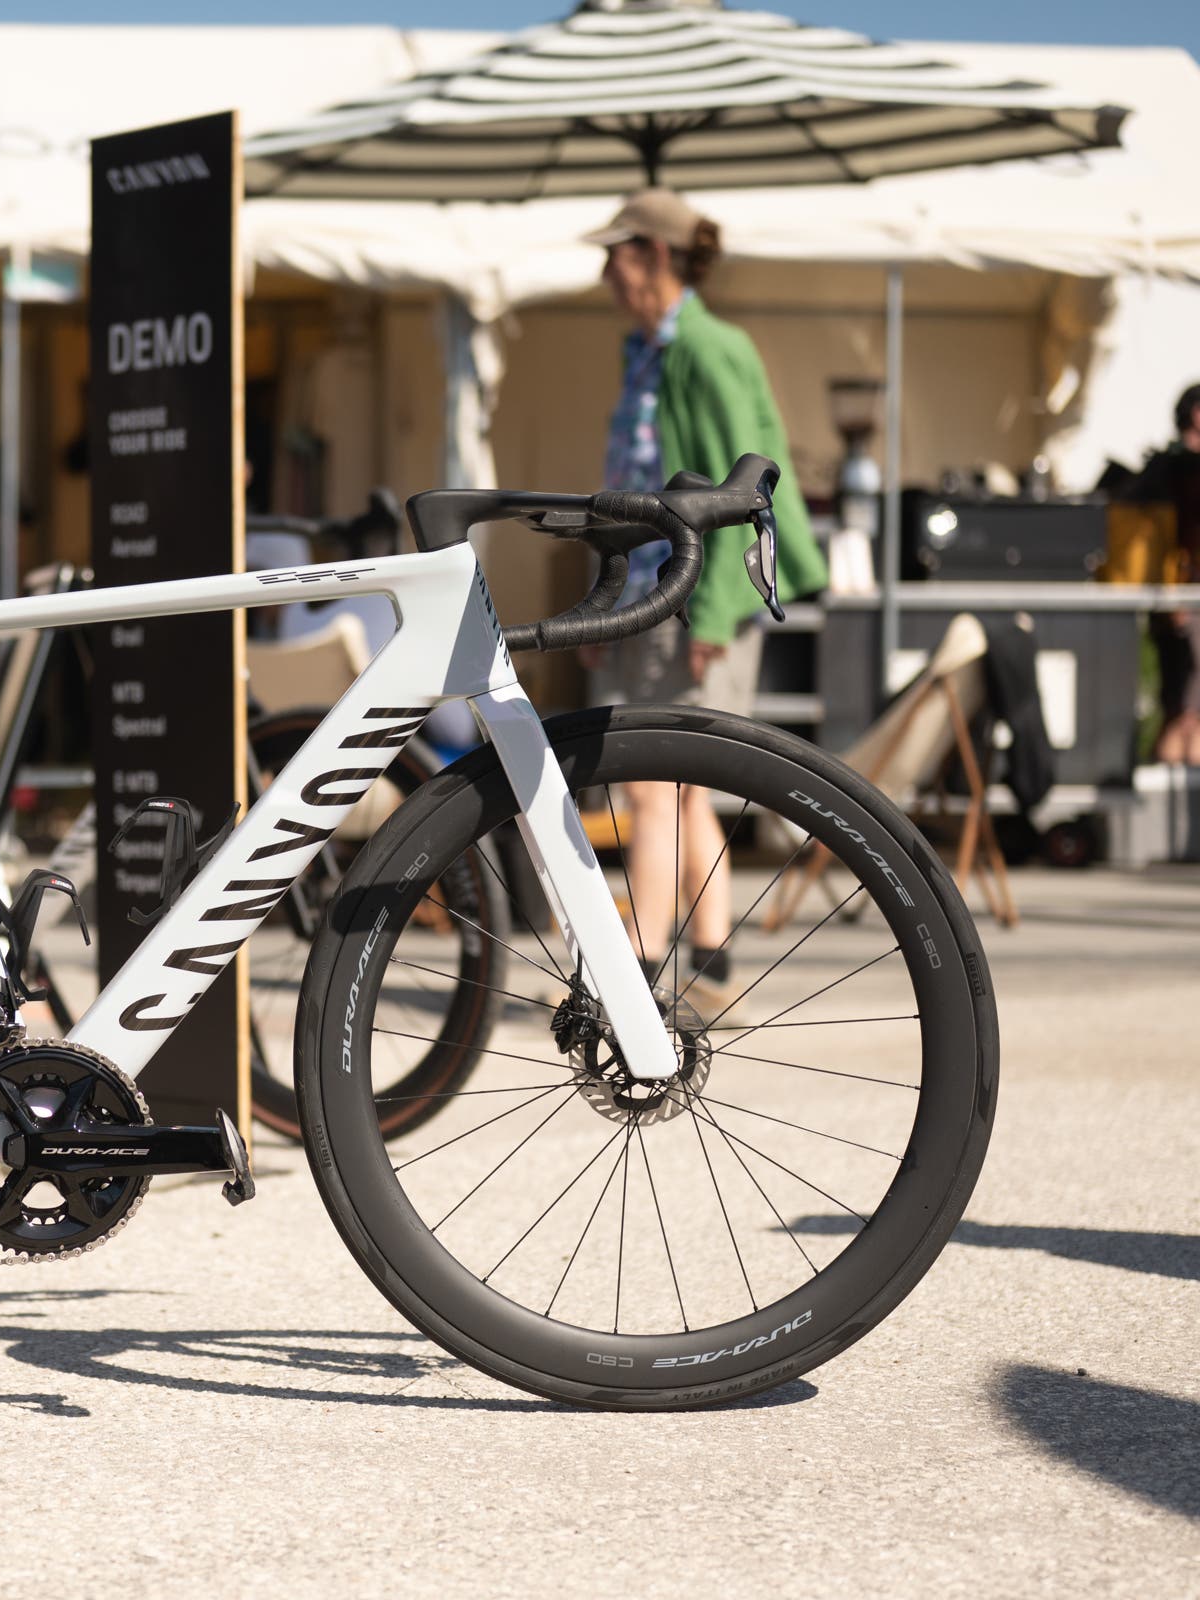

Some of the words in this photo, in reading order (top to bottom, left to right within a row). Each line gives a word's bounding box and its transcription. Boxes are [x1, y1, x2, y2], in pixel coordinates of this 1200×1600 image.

[106, 154, 211, 193] CANYON
[108, 312, 213, 374] DEMO
[119, 707, 433, 1031] CANYON
[787, 790, 915, 907] DURA-ACE
[916, 923, 942, 969] C50
[343, 906, 389, 1073] DURA-ACE
[395, 853, 429, 893] C50
[41, 1147, 150, 1156] DURA-ACE
[652, 1309, 812, 1368] DURA-ACE
[586, 1352, 633, 1368] C50
[749, 1363, 794, 1386] MADE
[669, 1388, 721, 1402] ITALY
[727, 1382, 744, 1393] IN
